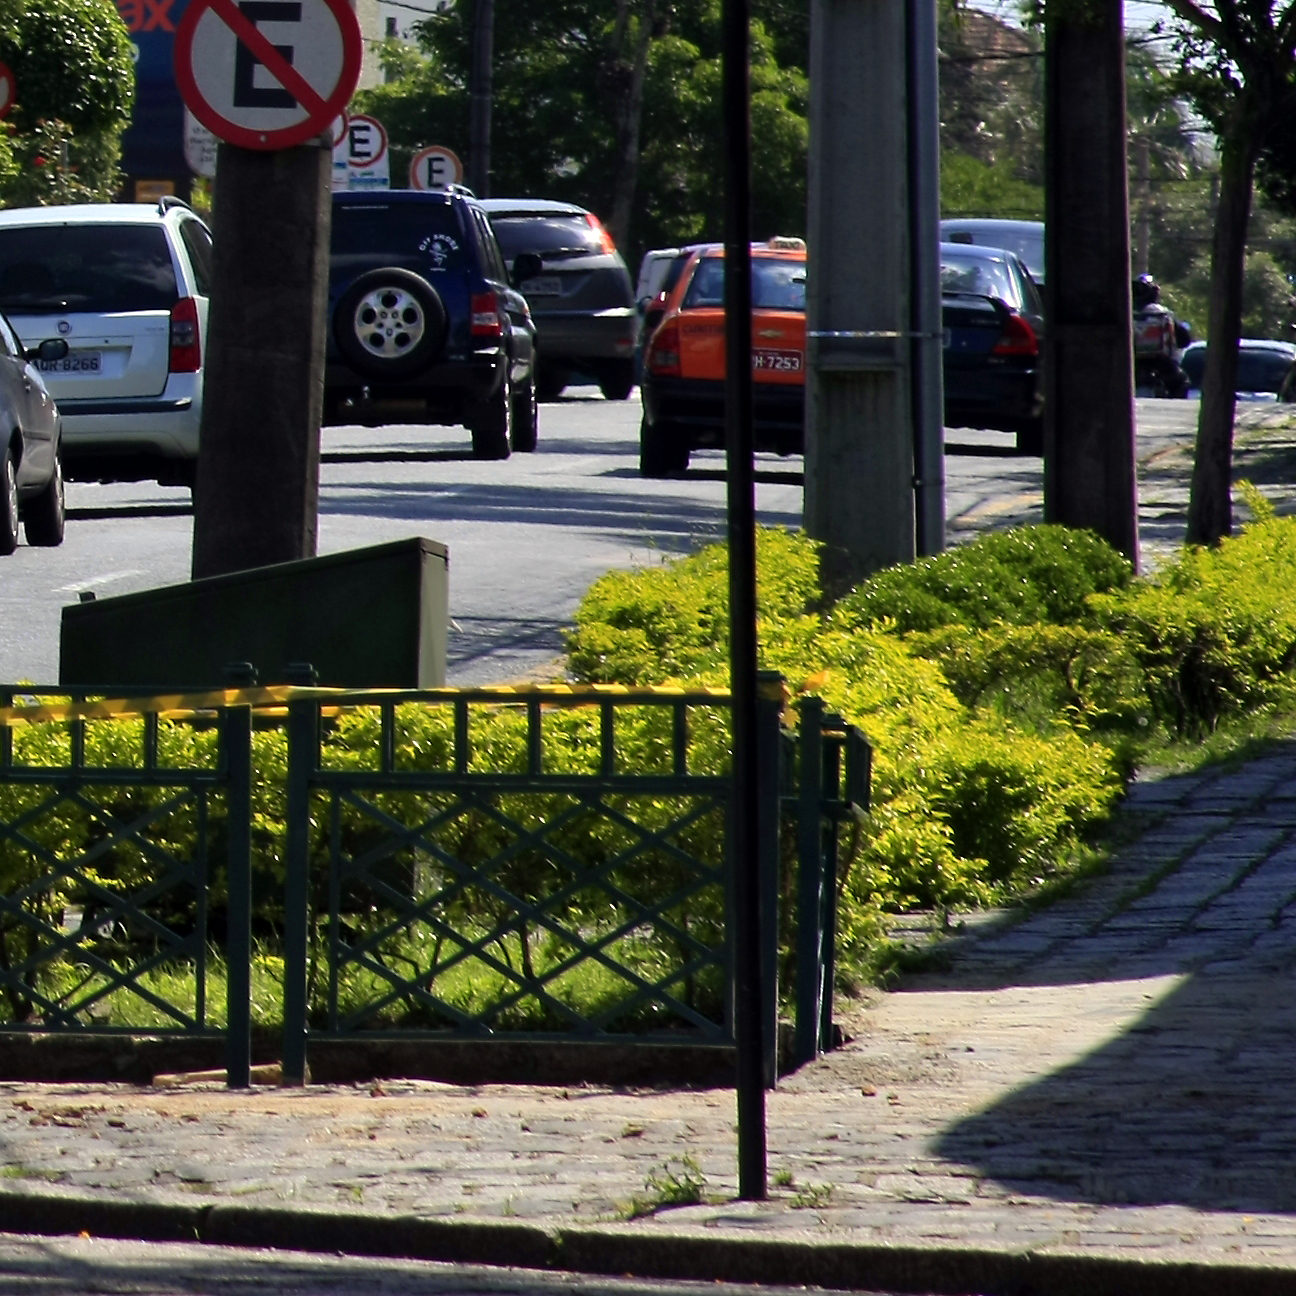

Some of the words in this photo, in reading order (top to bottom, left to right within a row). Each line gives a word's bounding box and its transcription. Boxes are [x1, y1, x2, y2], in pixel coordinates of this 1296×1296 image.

[232, 1, 303, 109] E
[349, 124, 373, 158] E
[427, 156, 446, 189] E
[751, 357, 801, 371] H-7253
